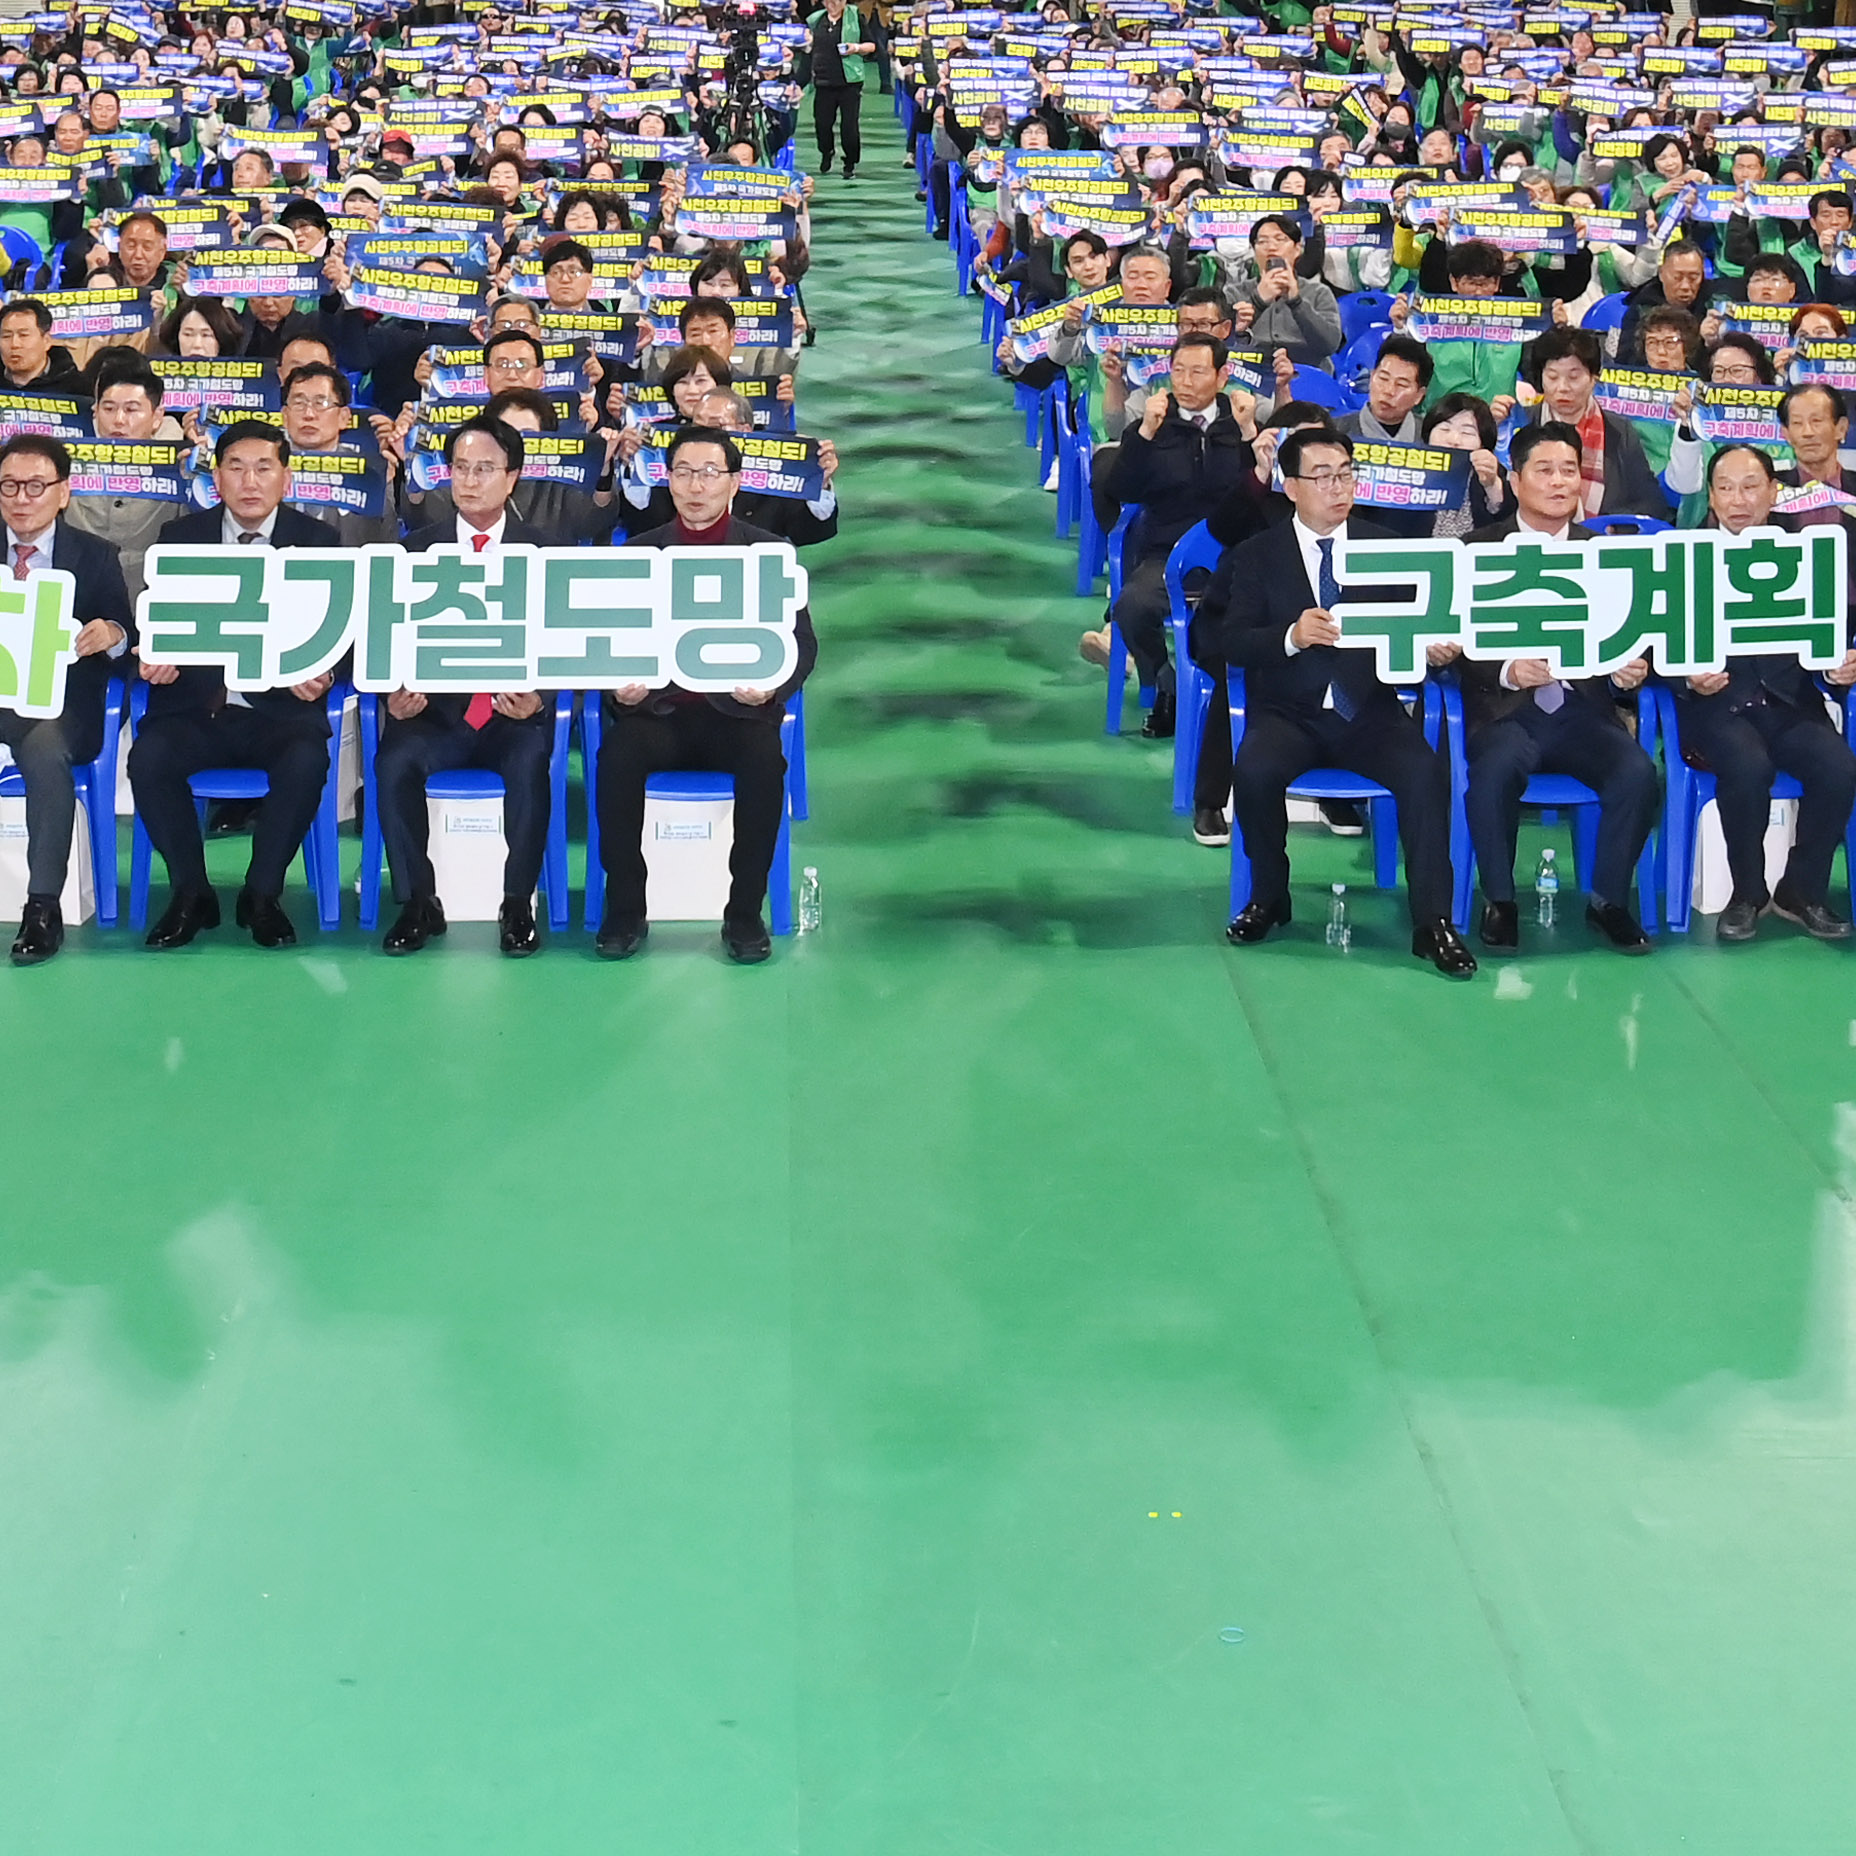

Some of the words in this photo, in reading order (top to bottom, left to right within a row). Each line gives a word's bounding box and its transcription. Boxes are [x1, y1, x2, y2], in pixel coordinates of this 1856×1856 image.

[194, 250, 315, 265] 사천우주항공철도!
[1420, 298, 1542, 317] 사천우주항공철도!
[147, 556, 796, 682] 국가철도망
[1342, 537, 1836, 672] 구축계획
